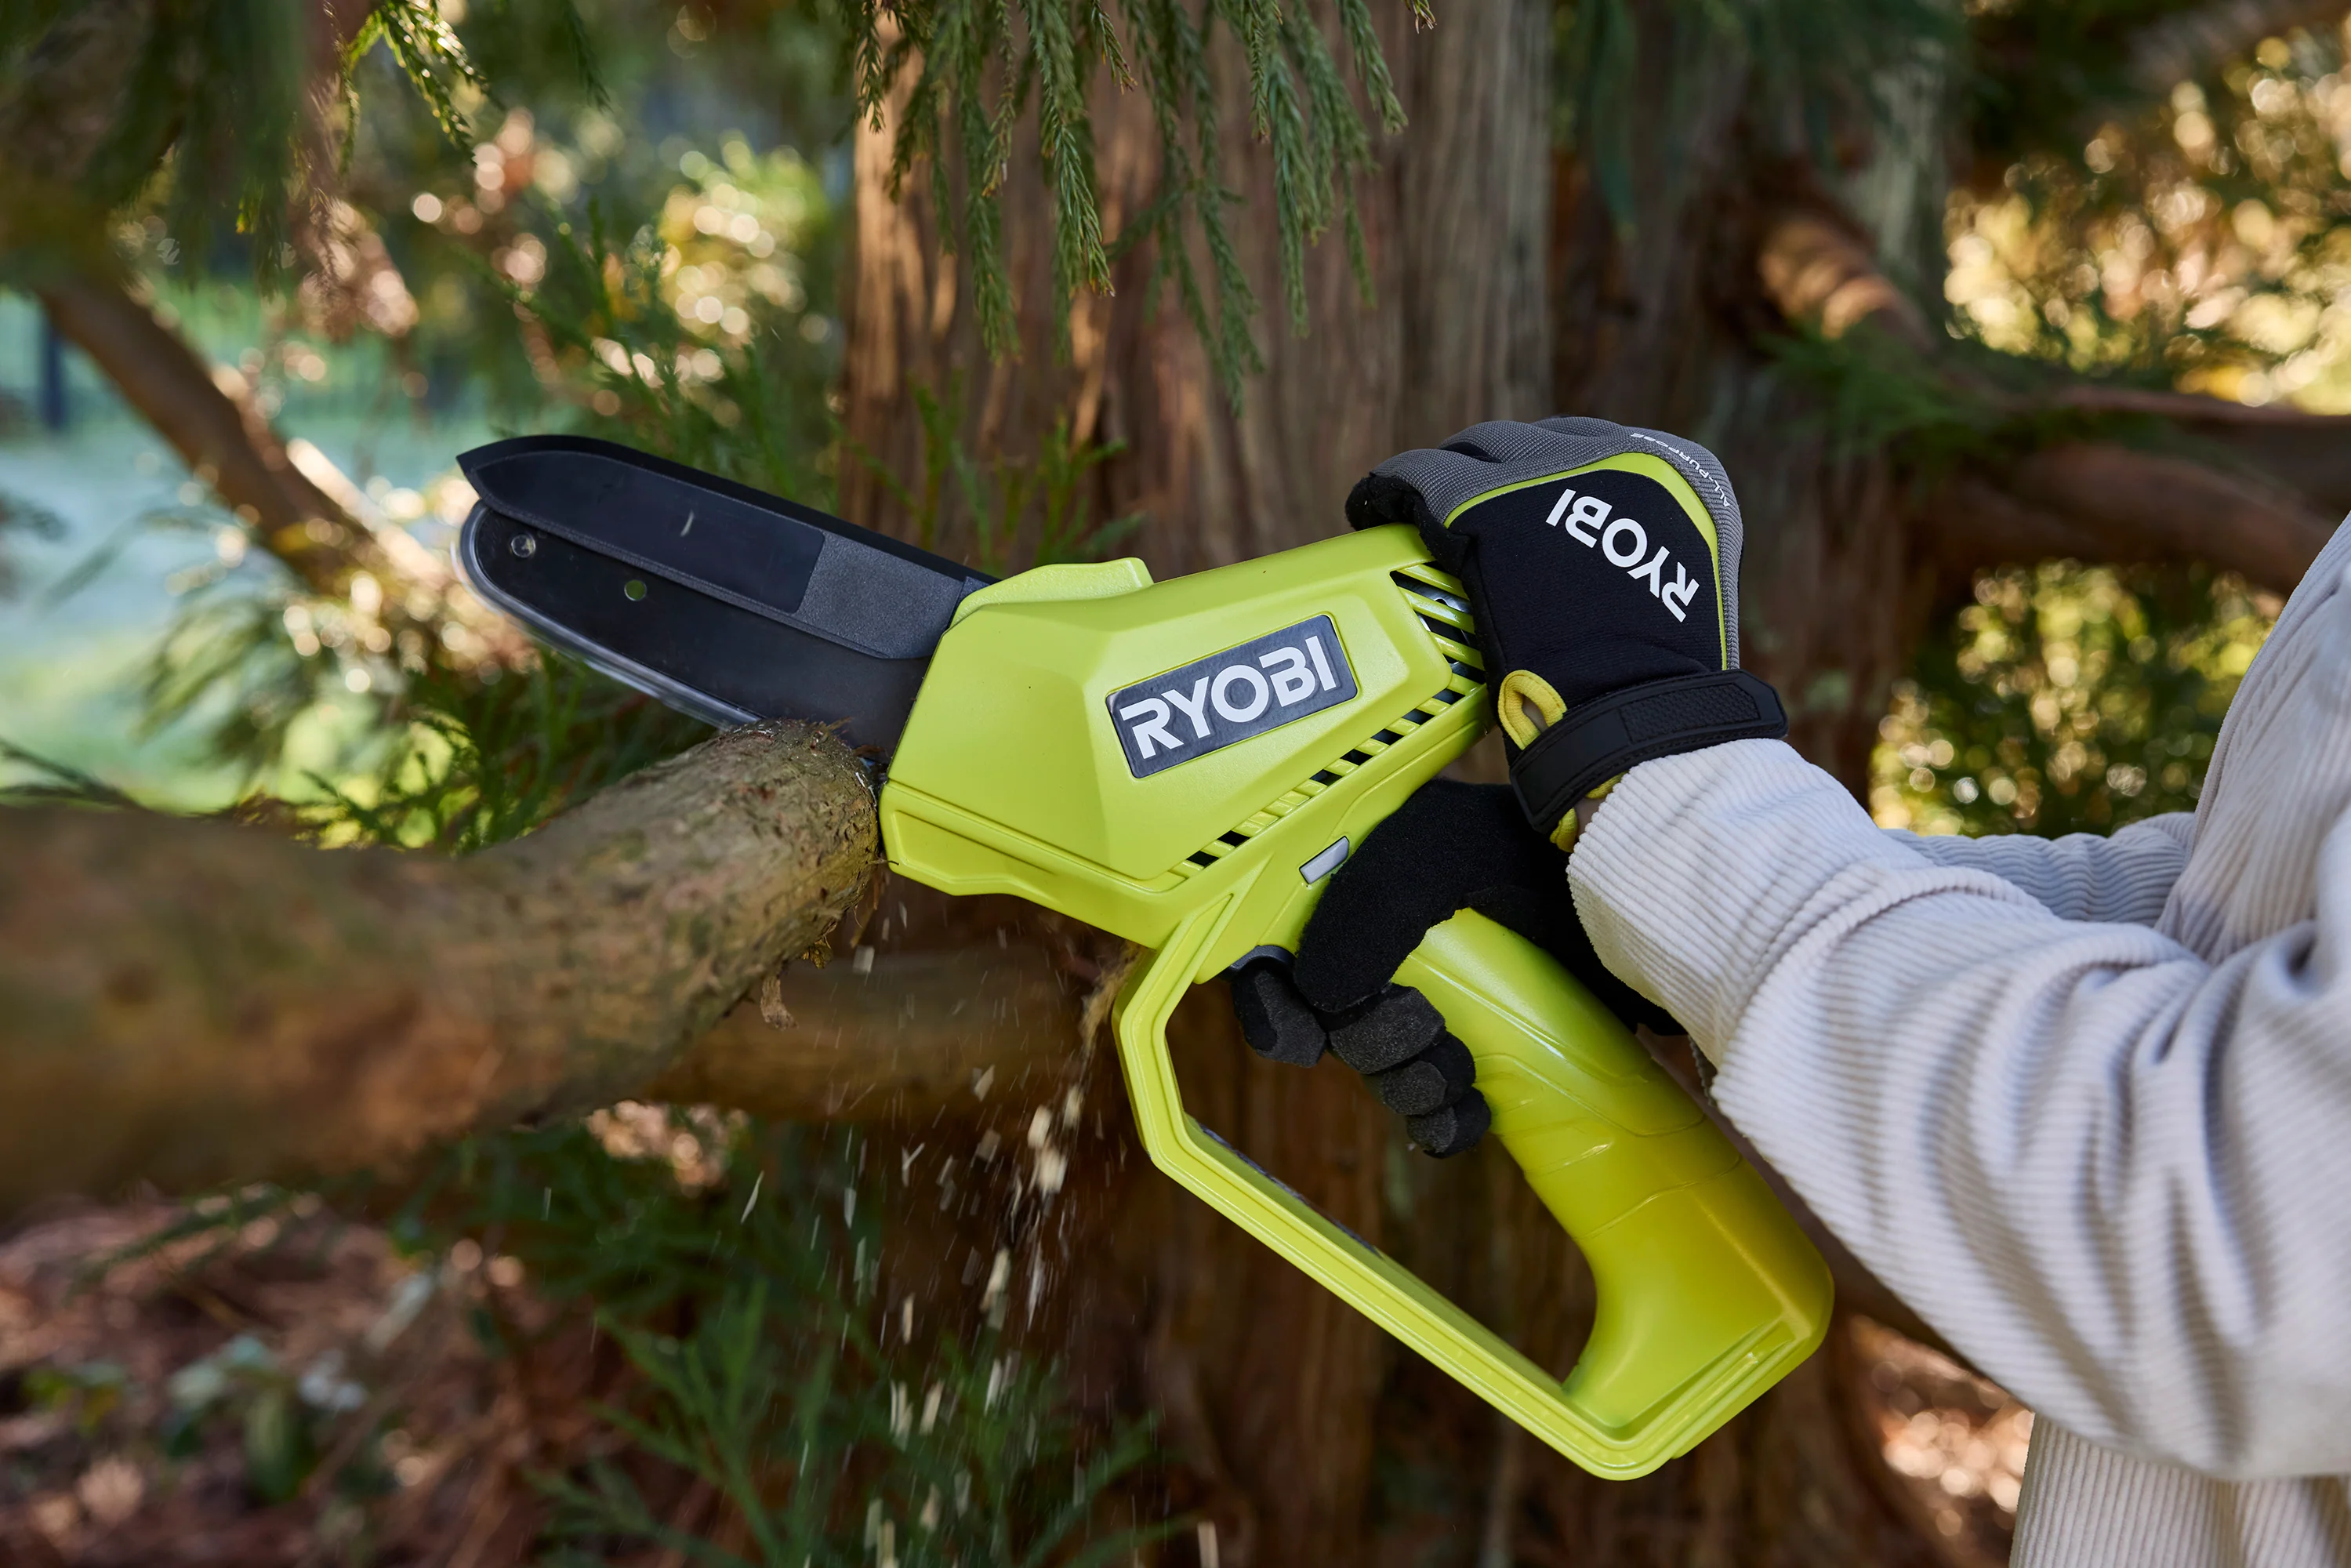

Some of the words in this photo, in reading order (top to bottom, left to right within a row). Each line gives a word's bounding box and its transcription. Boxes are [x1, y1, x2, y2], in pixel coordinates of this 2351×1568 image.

[1631, 433, 1730, 507] ALL-PURPOSE
[1546, 489, 1700, 622] RYOBI
[1119, 636, 1337, 760] RYOBI
